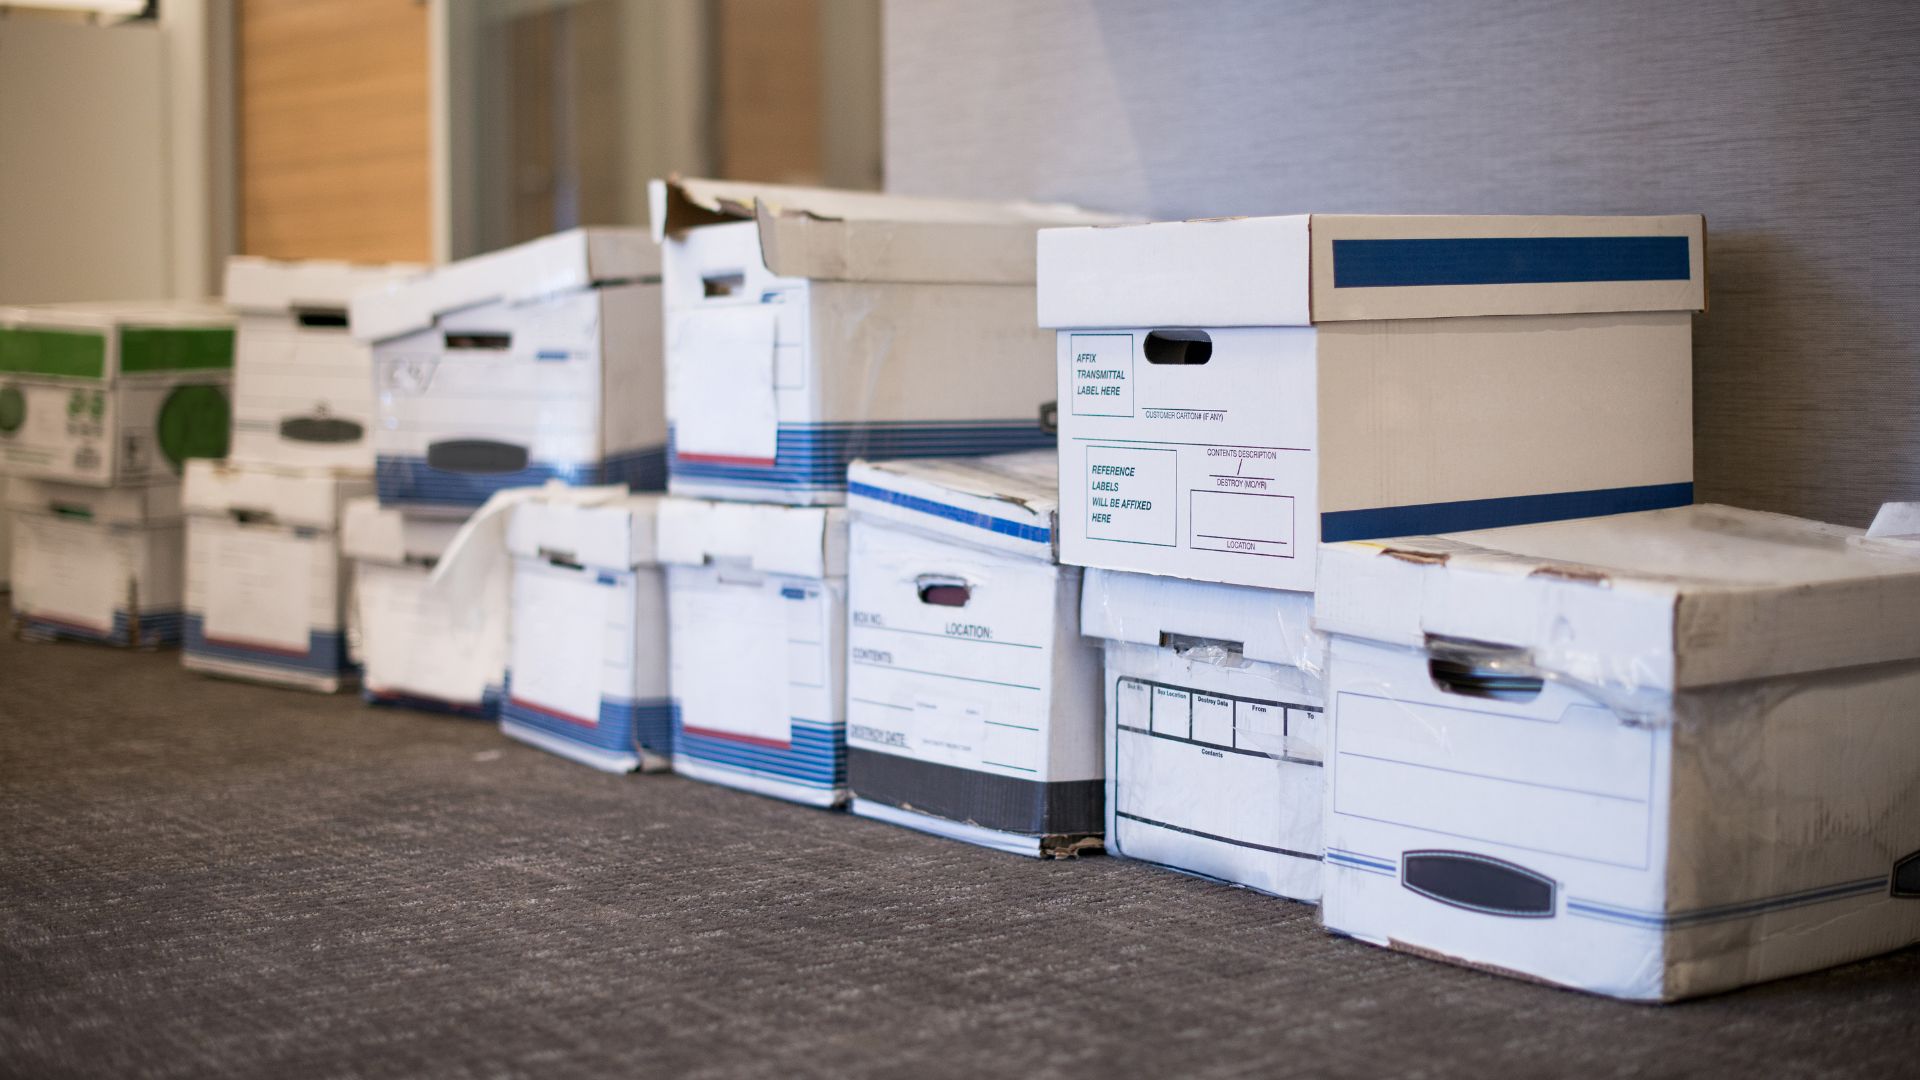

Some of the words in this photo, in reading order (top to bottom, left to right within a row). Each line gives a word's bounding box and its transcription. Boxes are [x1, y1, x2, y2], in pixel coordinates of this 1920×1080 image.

[1077, 353, 1096, 363] AFFIX
[1077, 369, 1125, 379] TRANSMITTAL
[1077, 385, 1099, 395] LABEL
[1100, 386, 1120, 396] HERE
[1145, 410, 1175, 419] CUSTOMER
[1176, 411, 1201, 420] CARTON#
[1209, 413, 1224, 422] ANY)
[1207, 448, 1237, 458] CONTENTS
[1238, 449, 1276, 460] DESCRIPTION
[1092, 464, 1135, 477] REFERENCE
[1092, 481, 1119, 492] LABELS
[1217, 478, 1243, 488] DESTROY
[1244, 480, 1266, 490] (MO/YR)
[1092, 497, 1108, 507] WILL
[1109, 498, 1120, 508] BE
[1121, 499, 1152, 511] AFFIXED
[1092, 513, 1111, 523] HERE
[1226, 540, 1256, 551] LOCATION
[853, 610, 869, 624] BOX
[945, 622, 993, 639] LOCATION:
[1157, 688, 1166, 696] Box
[1166, 690, 1187, 700] Location
[1197, 696, 1216, 706] Destroy
[1216, 699, 1229, 708] Date
[1251, 705, 1267, 713] From
[1307, 712, 1315, 720] To
[850, 724, 884, 742] DESTROY
[1201, 748, 1223, 759] Contents
